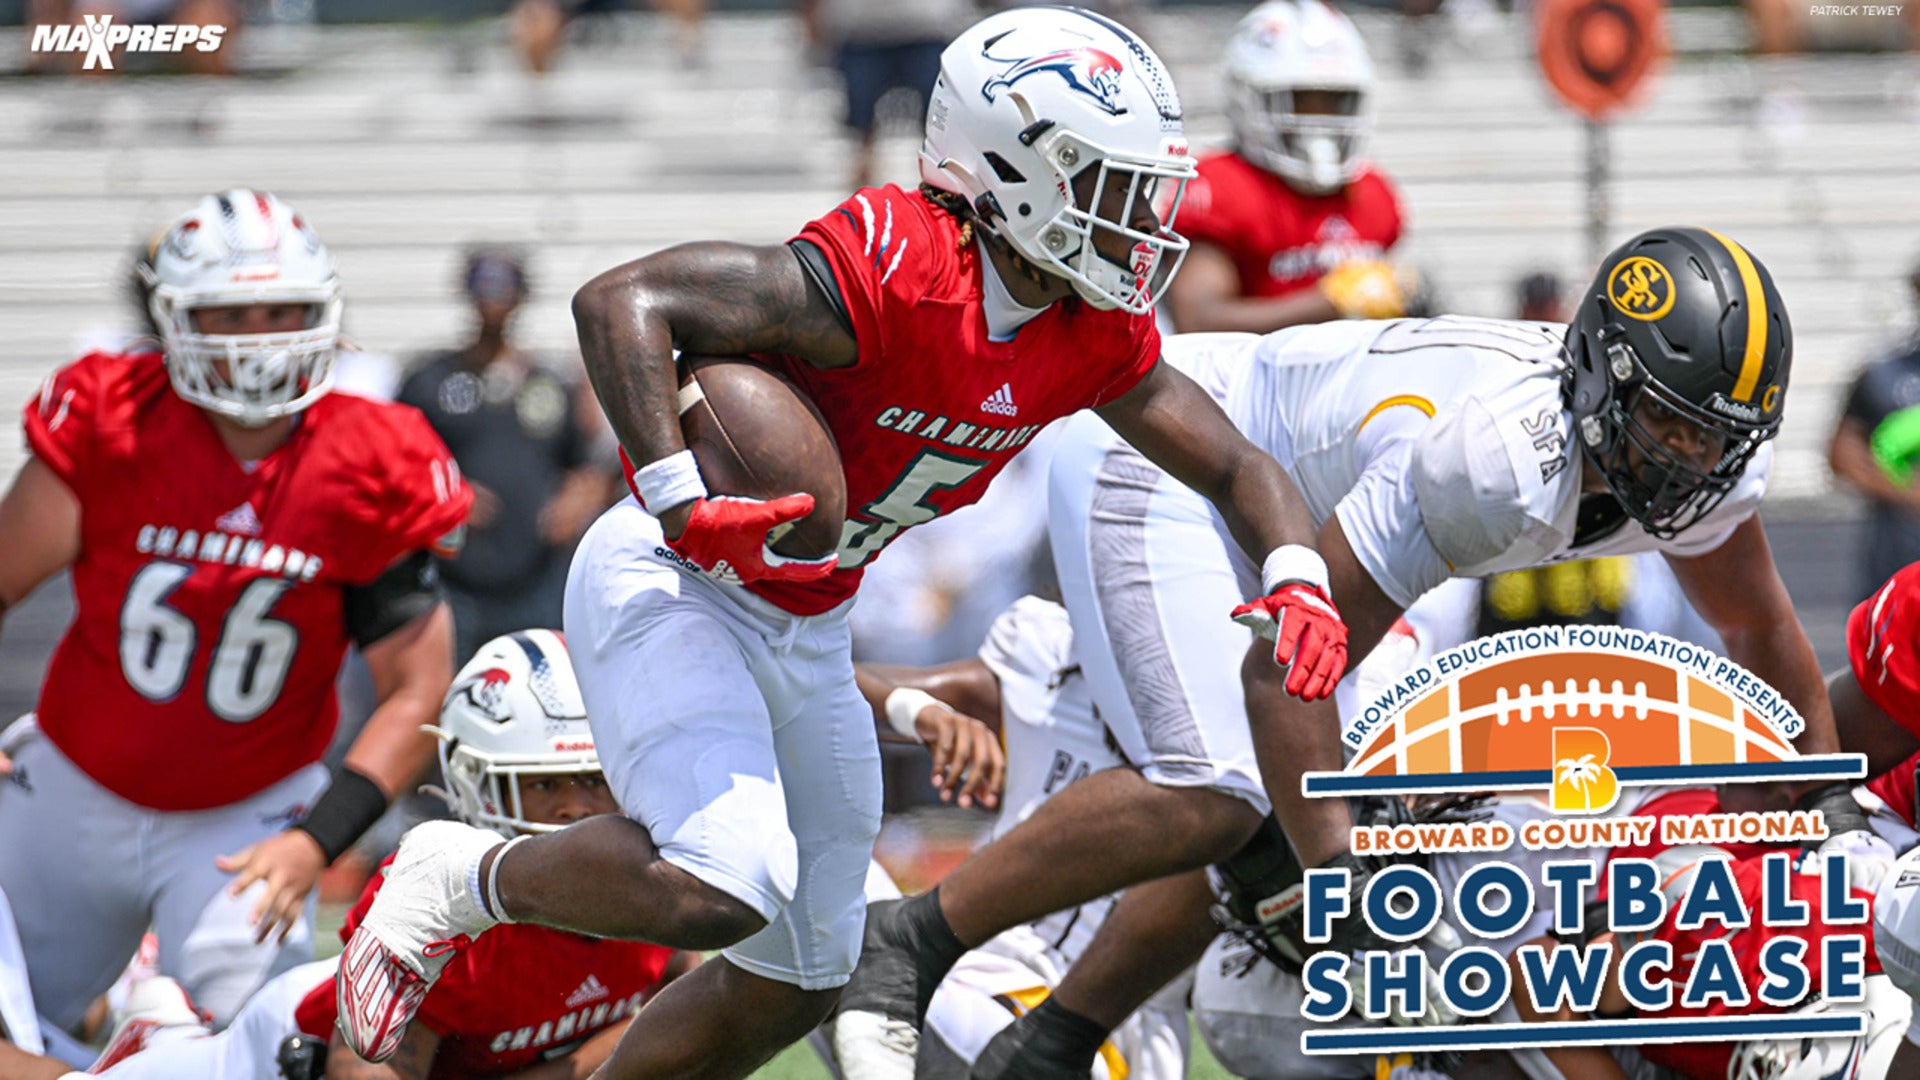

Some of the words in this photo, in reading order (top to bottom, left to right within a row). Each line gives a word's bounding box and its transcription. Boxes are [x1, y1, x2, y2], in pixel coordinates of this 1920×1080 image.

[981, 401, 1018, 417] adidas
[1713, 397, 1761, 419] Riddell
[1521, 409, 1567, 485] SFA
[654, 547, 700, 573] adidas
[119, 558, 299, 723] 66
